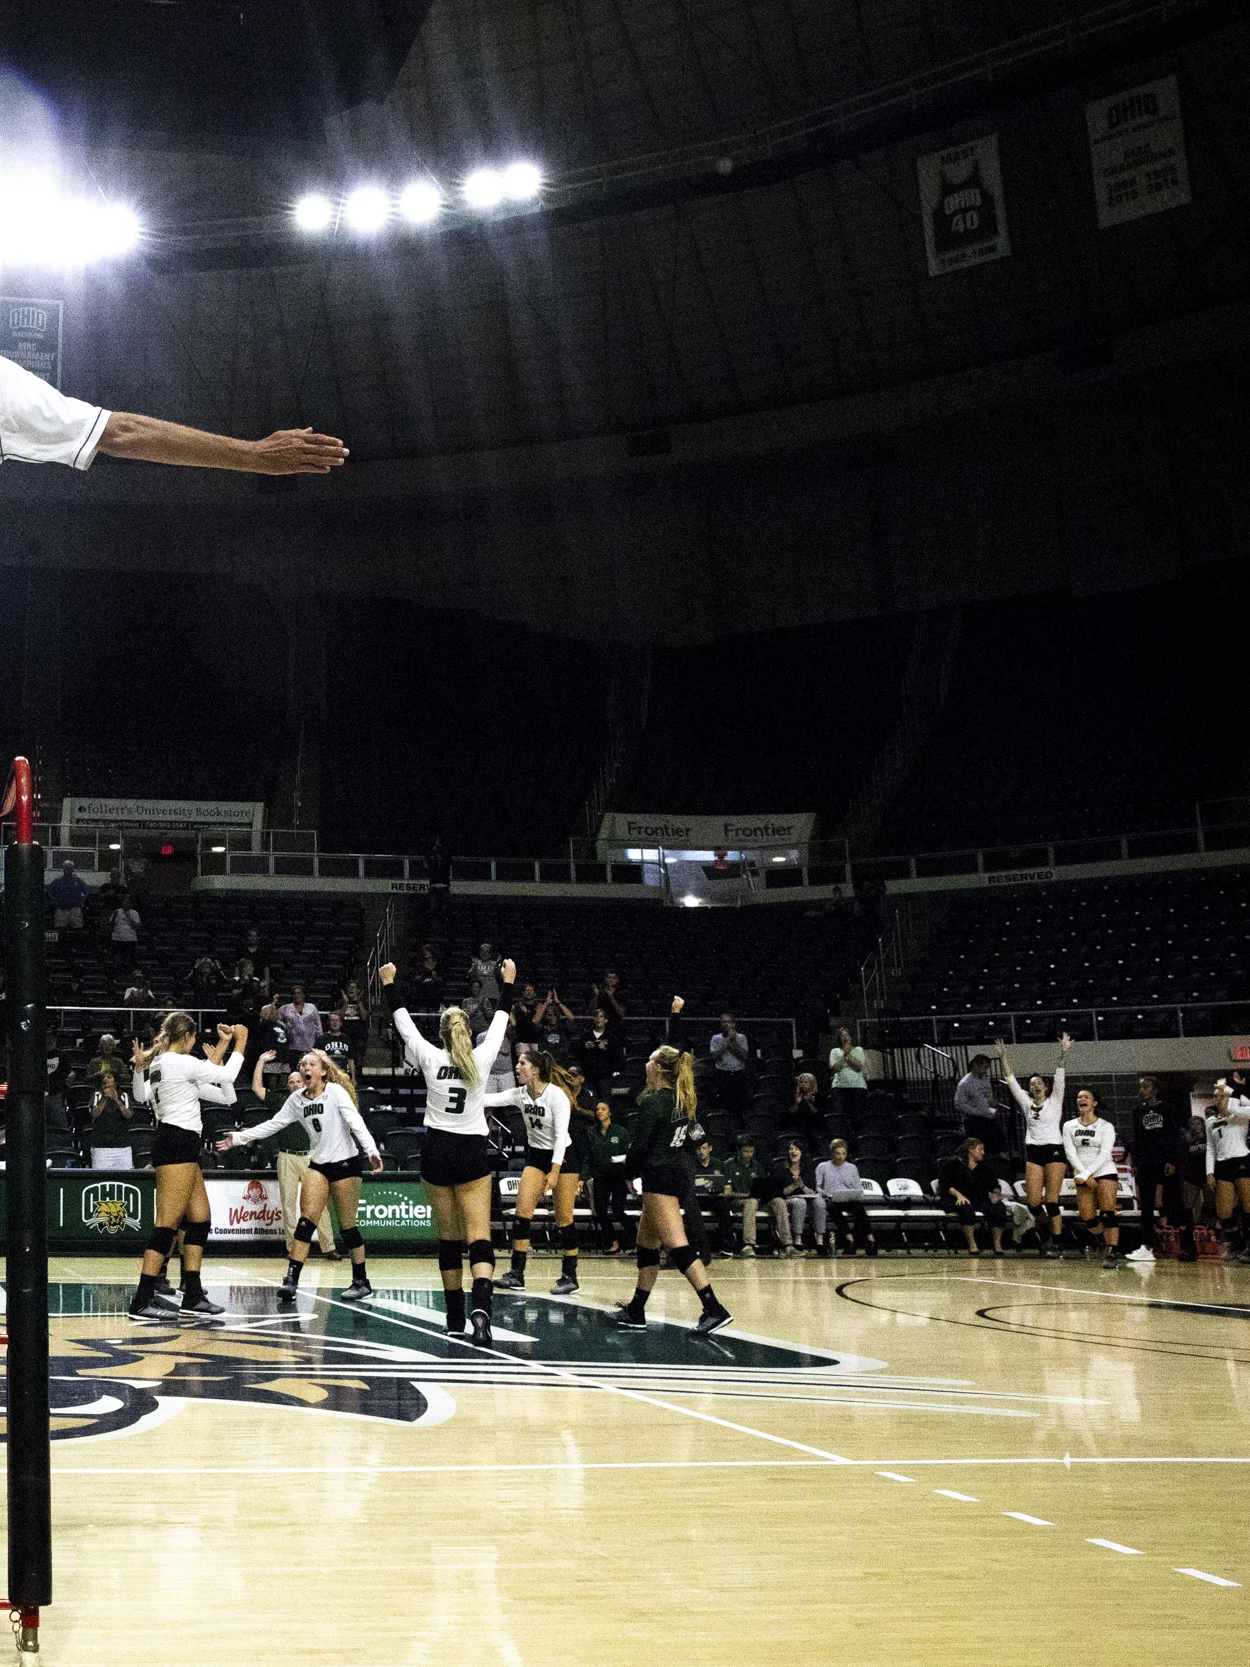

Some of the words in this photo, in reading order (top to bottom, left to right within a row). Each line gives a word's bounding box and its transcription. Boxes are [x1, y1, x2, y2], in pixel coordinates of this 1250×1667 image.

[1107, 92, 1158, 129] OHIO
[943, 189, 982, 216] OHIO
[951, 210, 980, 233] 40
[10, 307, 46, 331] OHIO
[136, 805, 193, 819] University
[196, 806, 251, 818] Bookstore
[626, 821, 692, 838] Frontier
[723, 820, 795, 838] Frontier
[987, 870, 1053, 885] RESERVED
[324, 1041, 349, 1052] OHIO
[437, 1066, 462, 1081] OH
[445, 1087, 467, 1114] 3
[304, 1103, 324, 1118] OHIO
[524, 1104, 545, 1118] OHIO
[529, 1116, 543, 1130] 14
[1074, 1129, 1096, 1138] OHIO
[507, 1180, 518, 1194] OH
[82, 1182, 141, 1223] OHIO
[229, 1203, 283, 1227] Wendy's
[214, 1227, 253, 1235] Convenient
[253, 1227, 278, 1235] Athens
